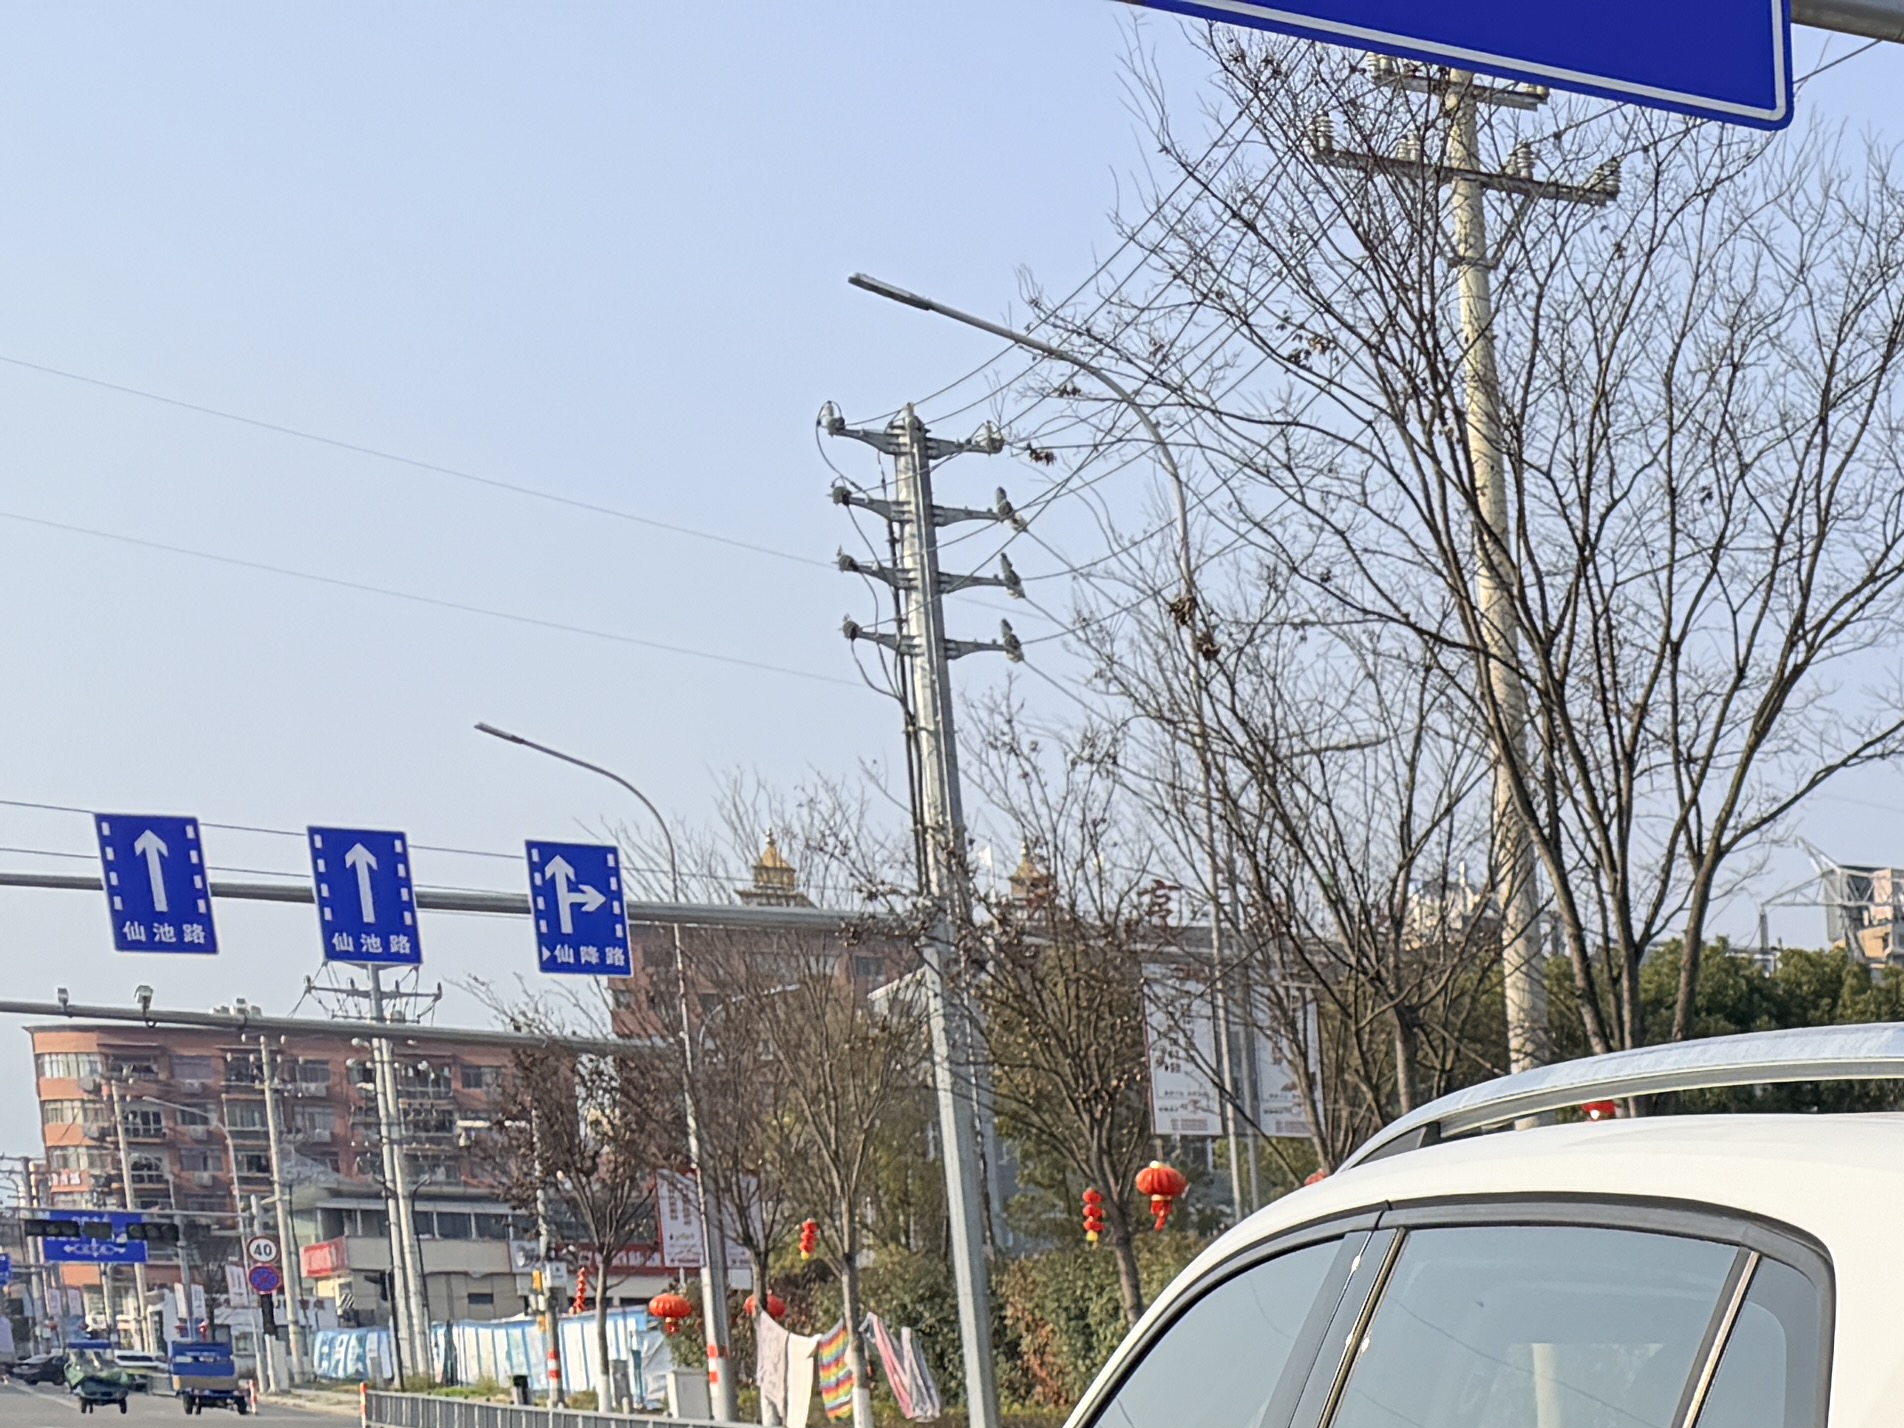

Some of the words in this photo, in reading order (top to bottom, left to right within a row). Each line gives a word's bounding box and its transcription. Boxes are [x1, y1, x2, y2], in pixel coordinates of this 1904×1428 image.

[122, 921, 205, 944] 仙池路
[331, 932, 411, 954] 仙池路
[253, 1243, 272, 1257] 40
